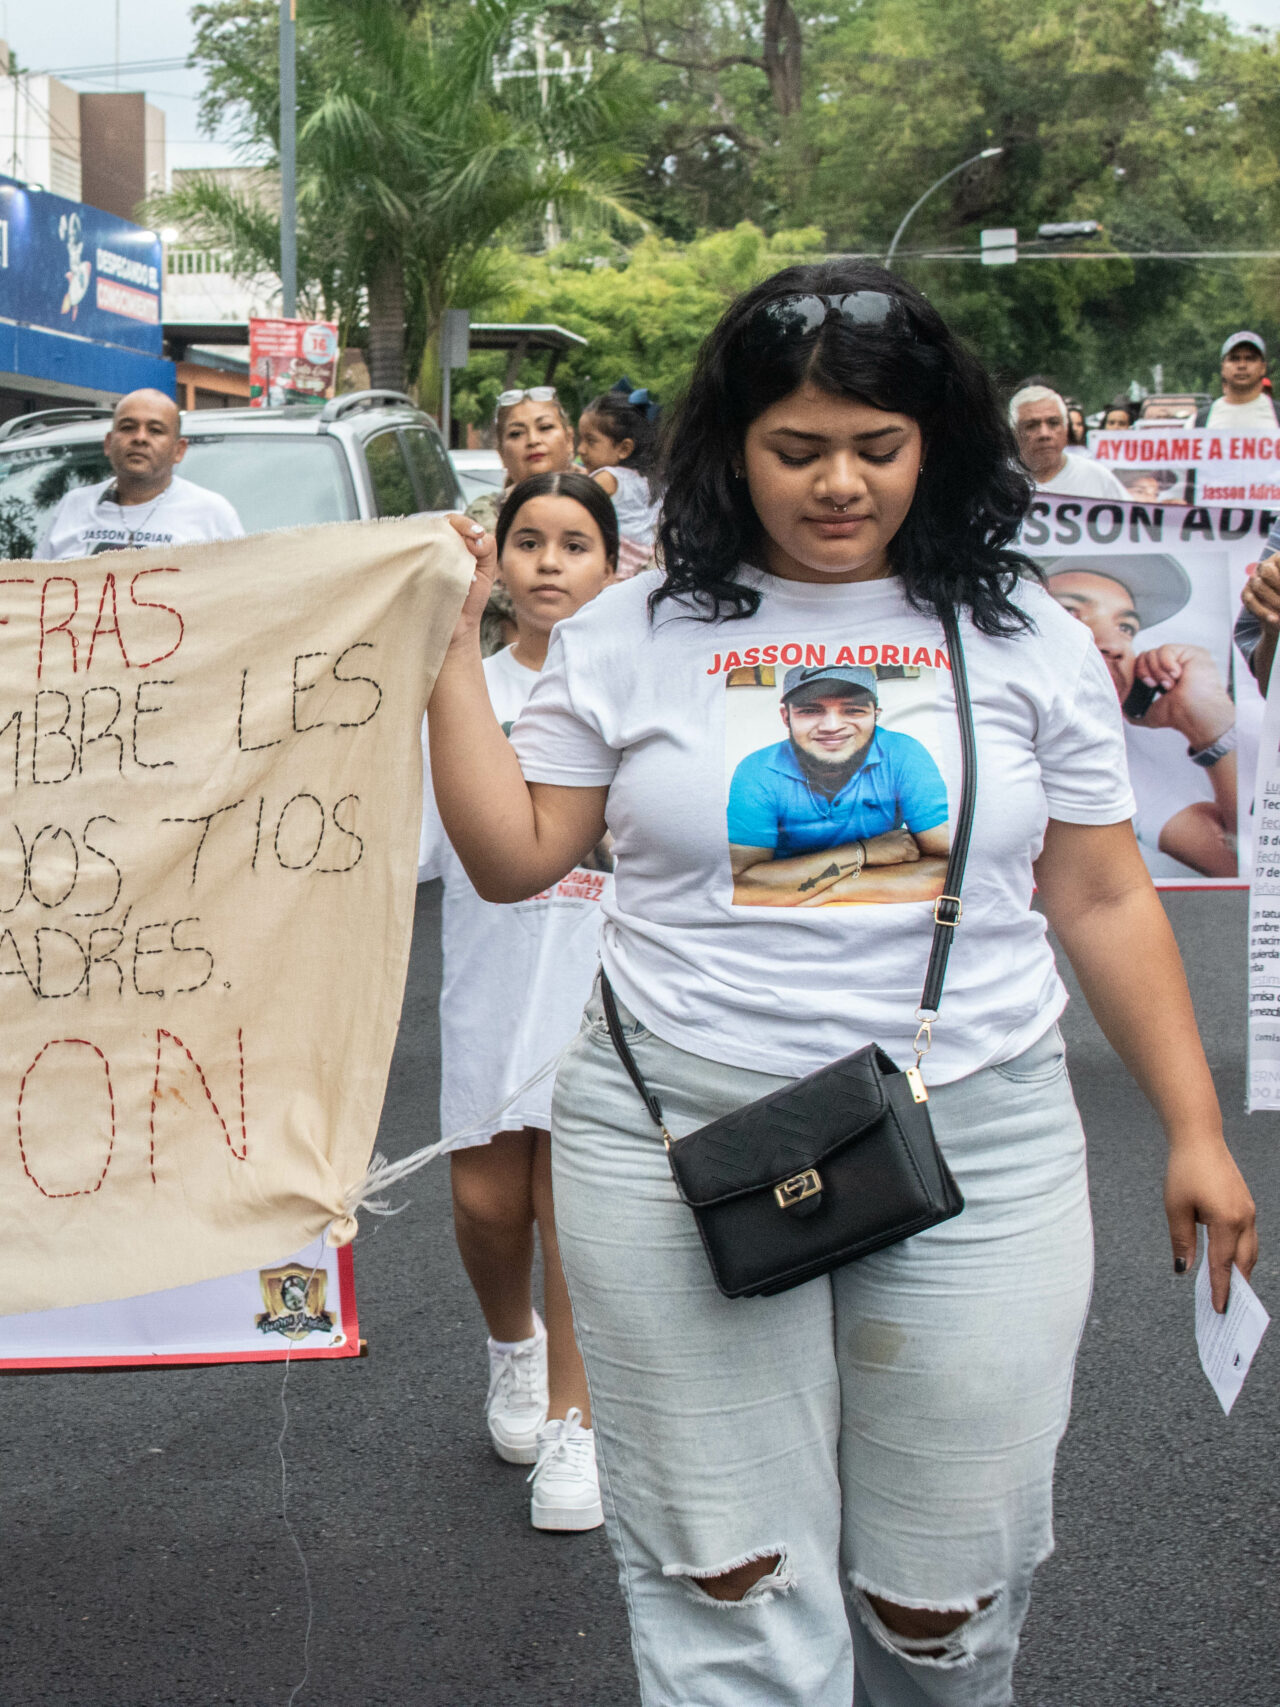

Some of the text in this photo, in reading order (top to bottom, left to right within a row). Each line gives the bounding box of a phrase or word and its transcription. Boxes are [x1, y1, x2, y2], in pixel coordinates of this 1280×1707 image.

[1095, 438, 1202, 462] AYUDAME
[1208, 438, 1223, 460] A
[82, 530, 124, 541] JASSON
[1017, 502, 1164, 545] SSON
[706, 643, 952, 675] JASSON ADRIAN
[237, 643, 382, 752] LES
[161, 793, 364, 886] TIOS
